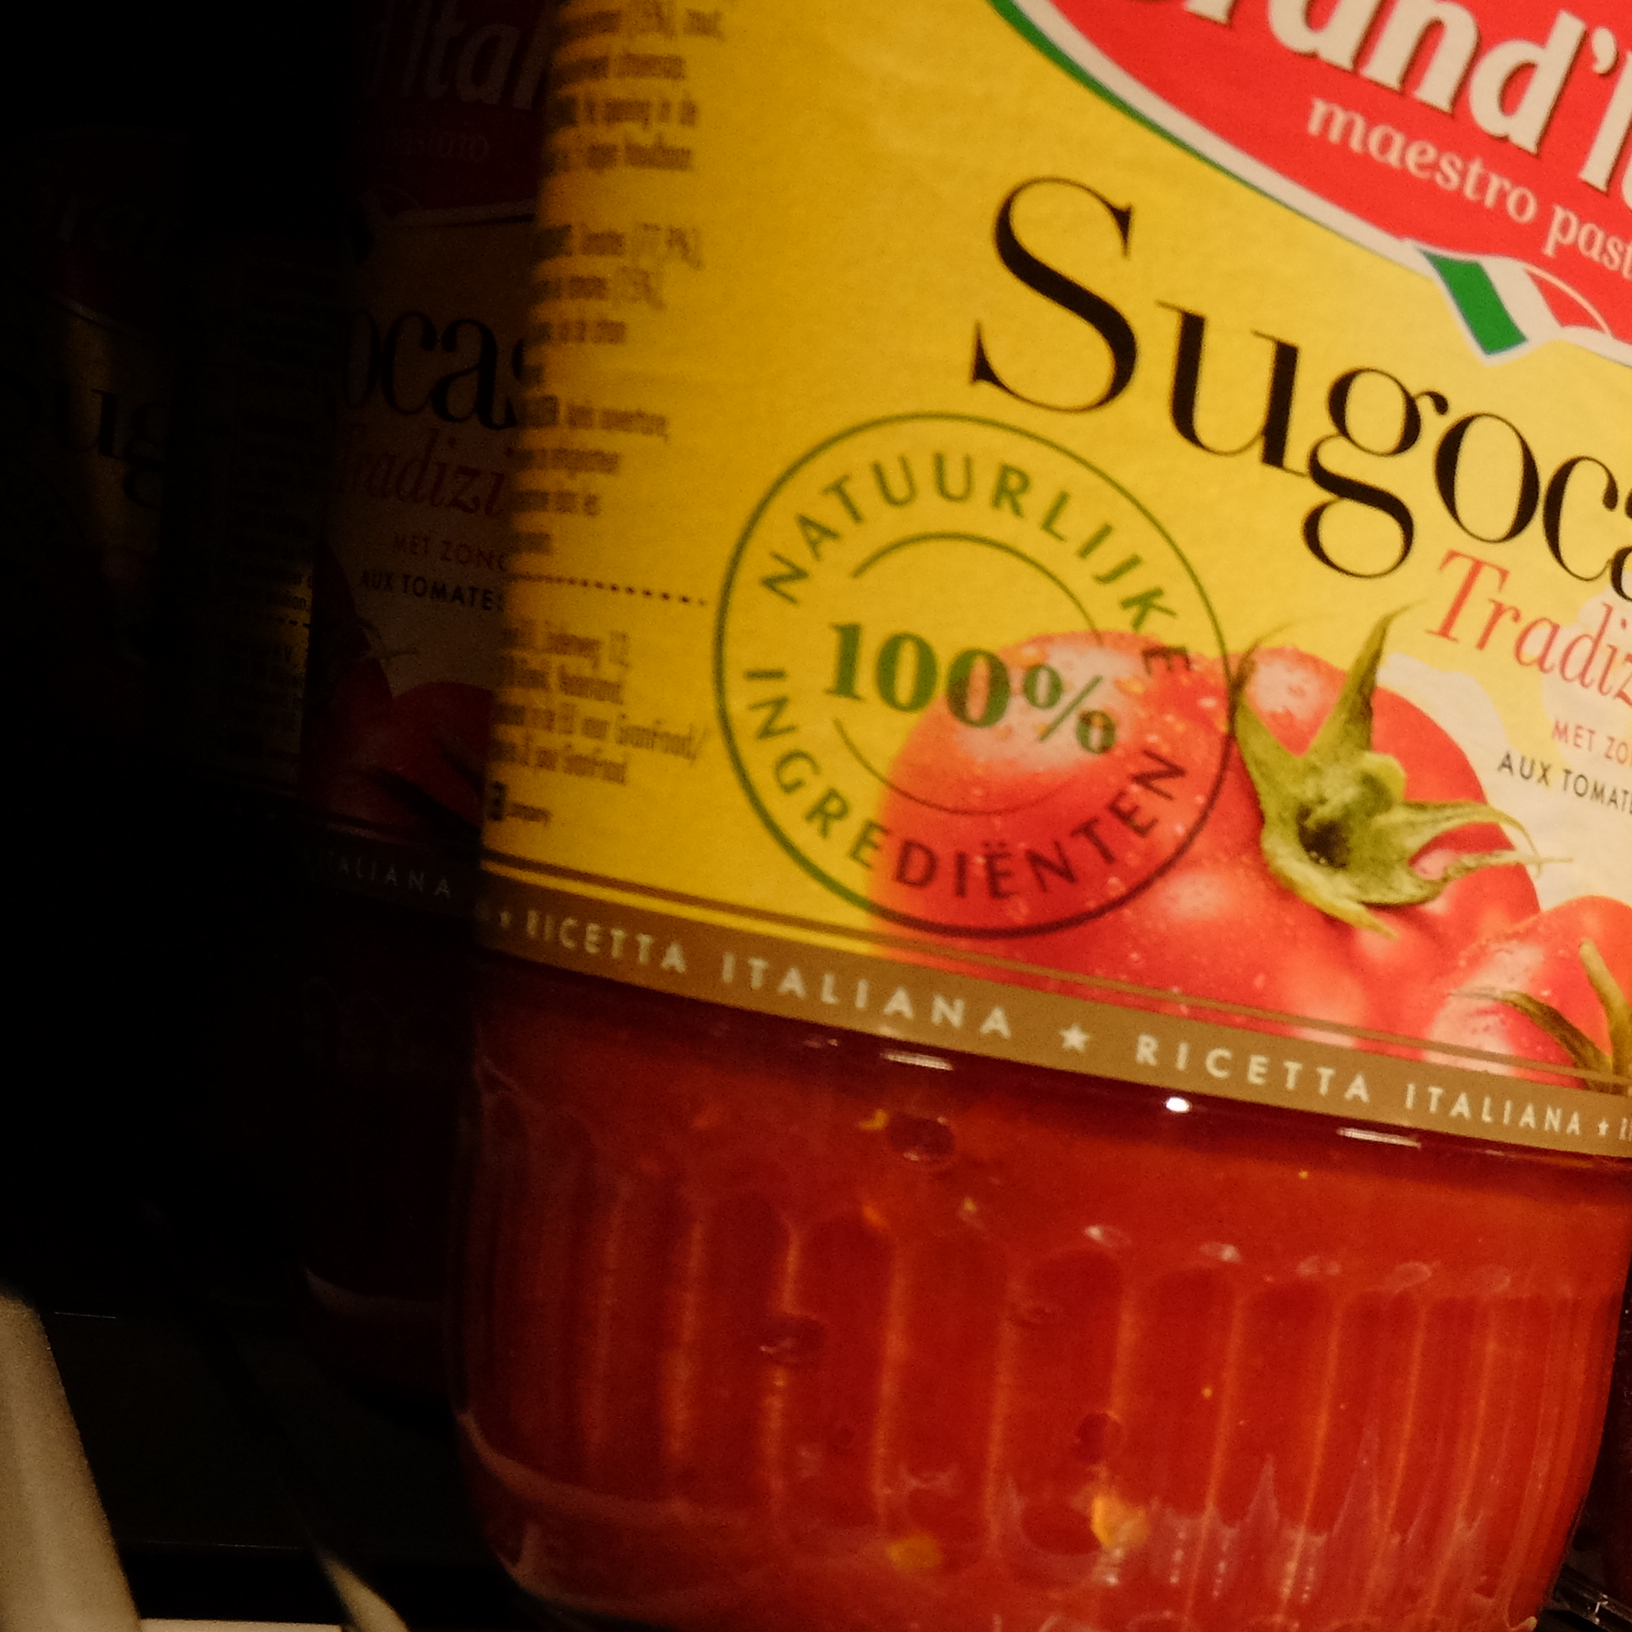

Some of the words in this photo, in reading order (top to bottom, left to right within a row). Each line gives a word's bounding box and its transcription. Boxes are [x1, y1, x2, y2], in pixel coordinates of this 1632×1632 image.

[1306, 97, 1540, 225] maestro
[760, 448, 1194, 677] NATUURLIJKE
[822, 621, 1118, 756] 100%
[1552, 720, 1597, 752] MET
[744, 665, 1189, 902] INGREDIËNTEN
[1497, 750, 1552, 787] AUX
[719, 952, 1013, 1042] ITALIANA
[1135, 1032, 1373, 1105] RICETTA
[1403, 1081, 1585, 1139] ITALIANA
